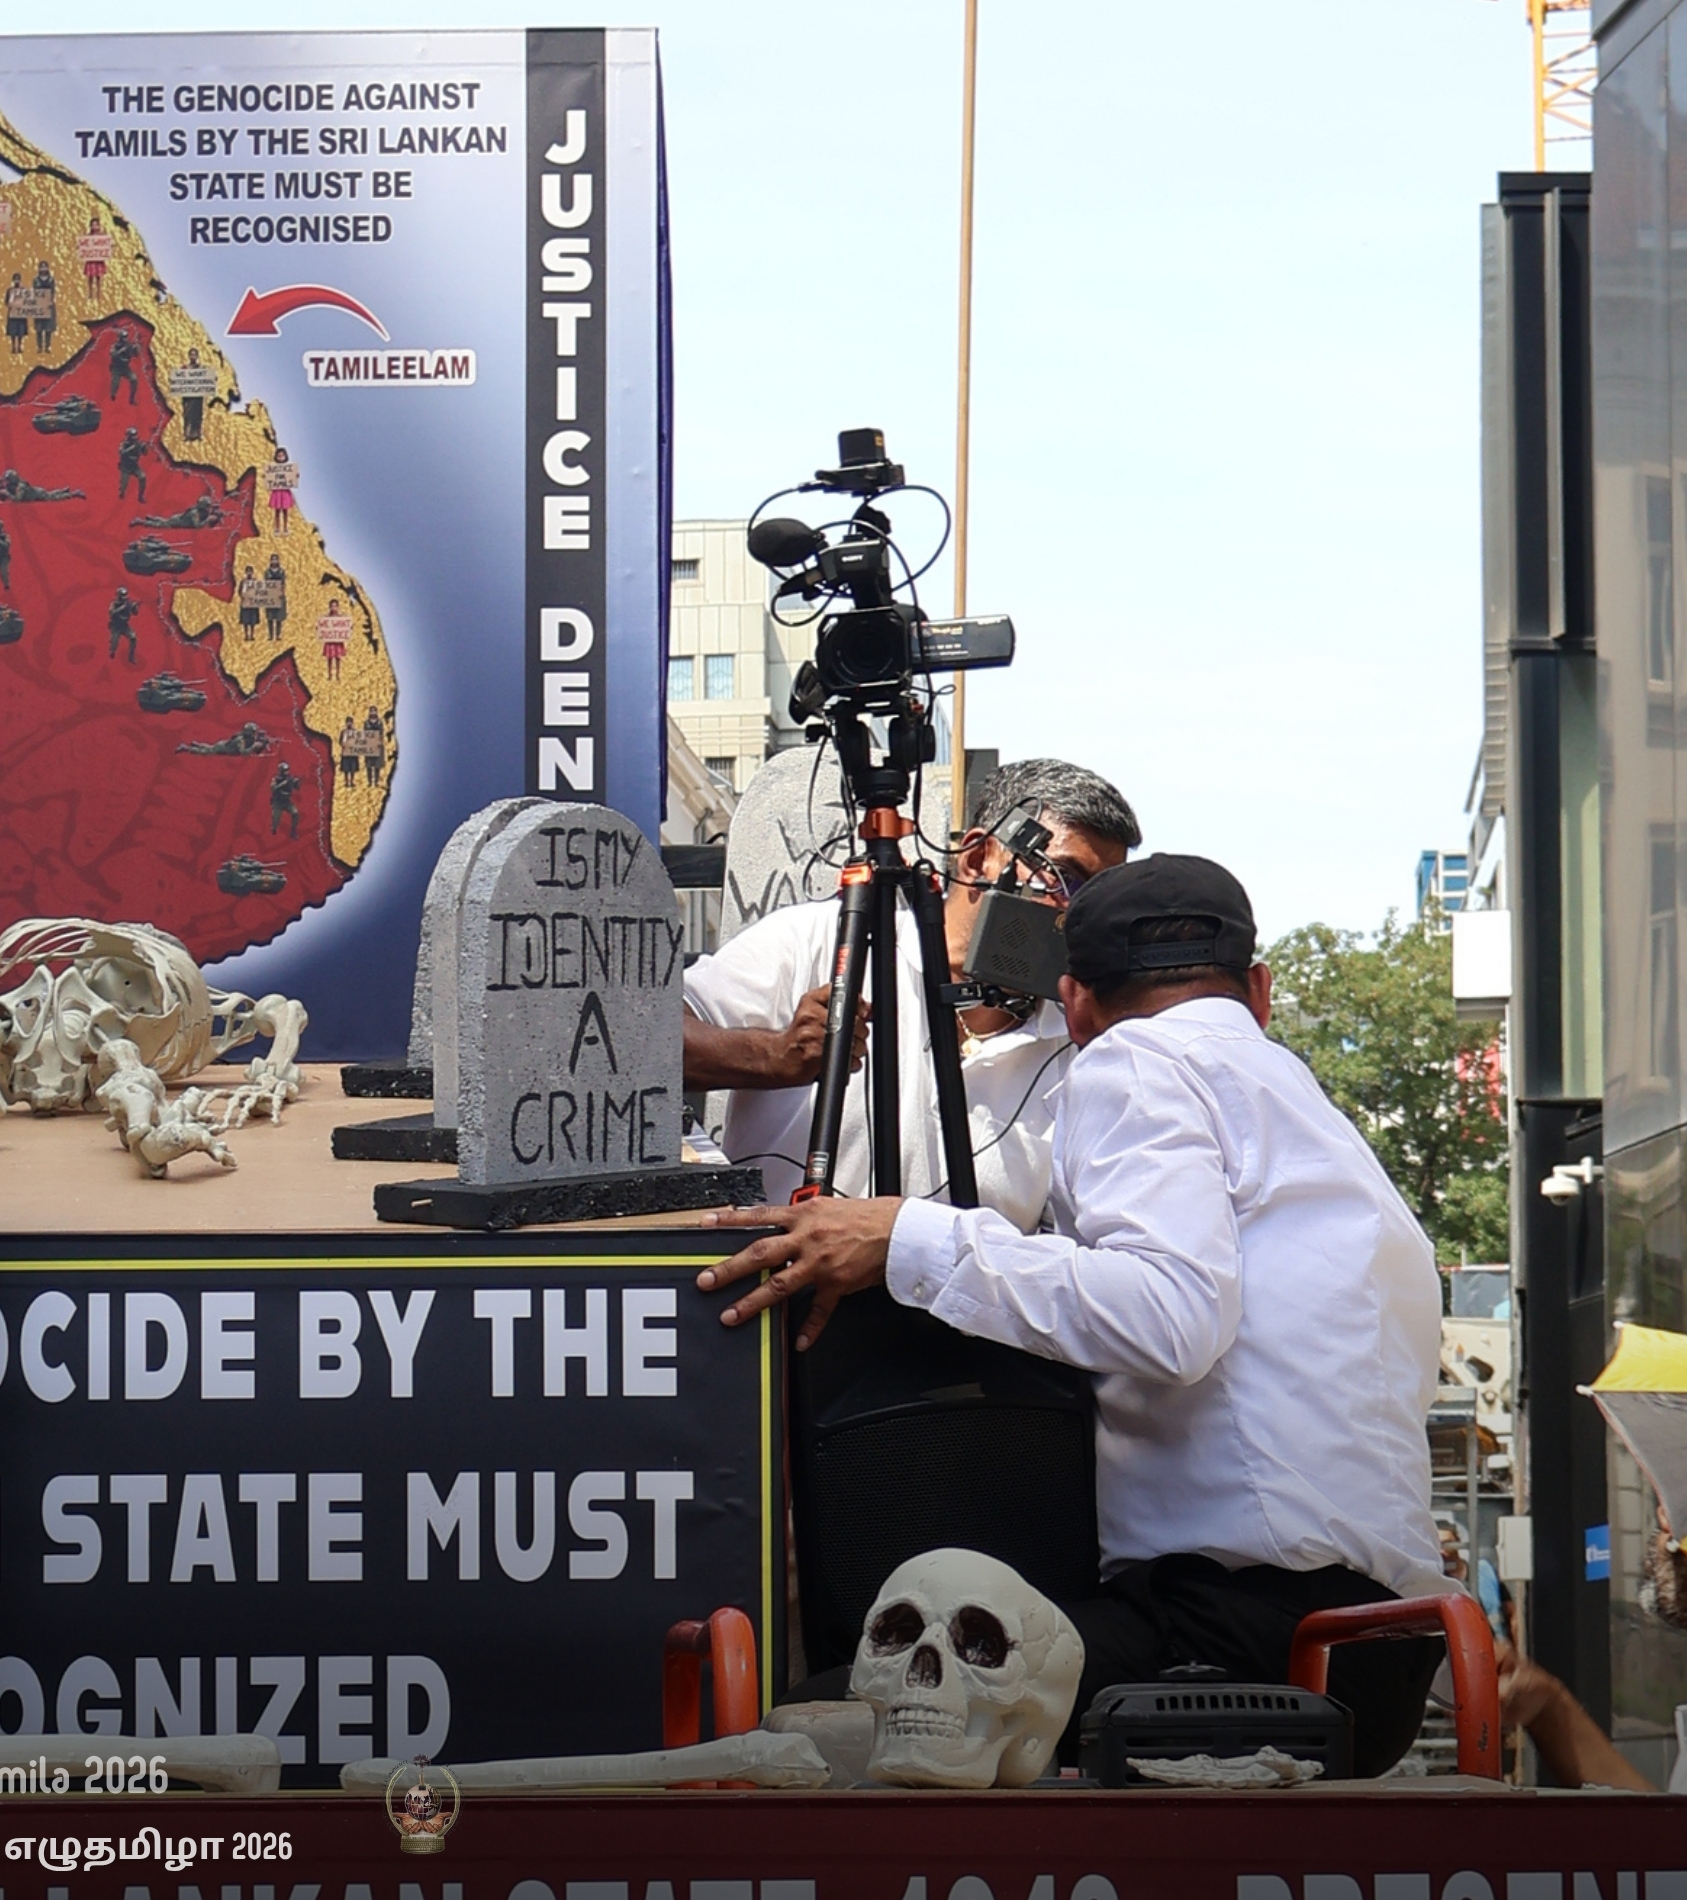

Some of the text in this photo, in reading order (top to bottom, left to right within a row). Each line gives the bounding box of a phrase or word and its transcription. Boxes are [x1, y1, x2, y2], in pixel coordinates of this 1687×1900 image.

[102, 83, 481, 113] THE GENOCIDE AGAINST
[75, 126, 508, 158] TAMILS BY THE SRI LANKAN
[169, 171, 413, 201] STATE MUST BE
[190, 215, 393, 244] RECOGNISED
[309, 355, 470, 380] TAMILEELAM
[539, 109, 595, 791] JUSTICE DEN
[486, 911, 685, 991] IDENTITY
[569, 990, 618, 1075] A
[511, 1086, 668, 1165] CRIME
[298, 1289, 437, 1399] BY
[472, 1288, 679, 1398] THE
[41, 1472, 364, 1584] STATE
[406, 1470, 695, 1582] MUST
